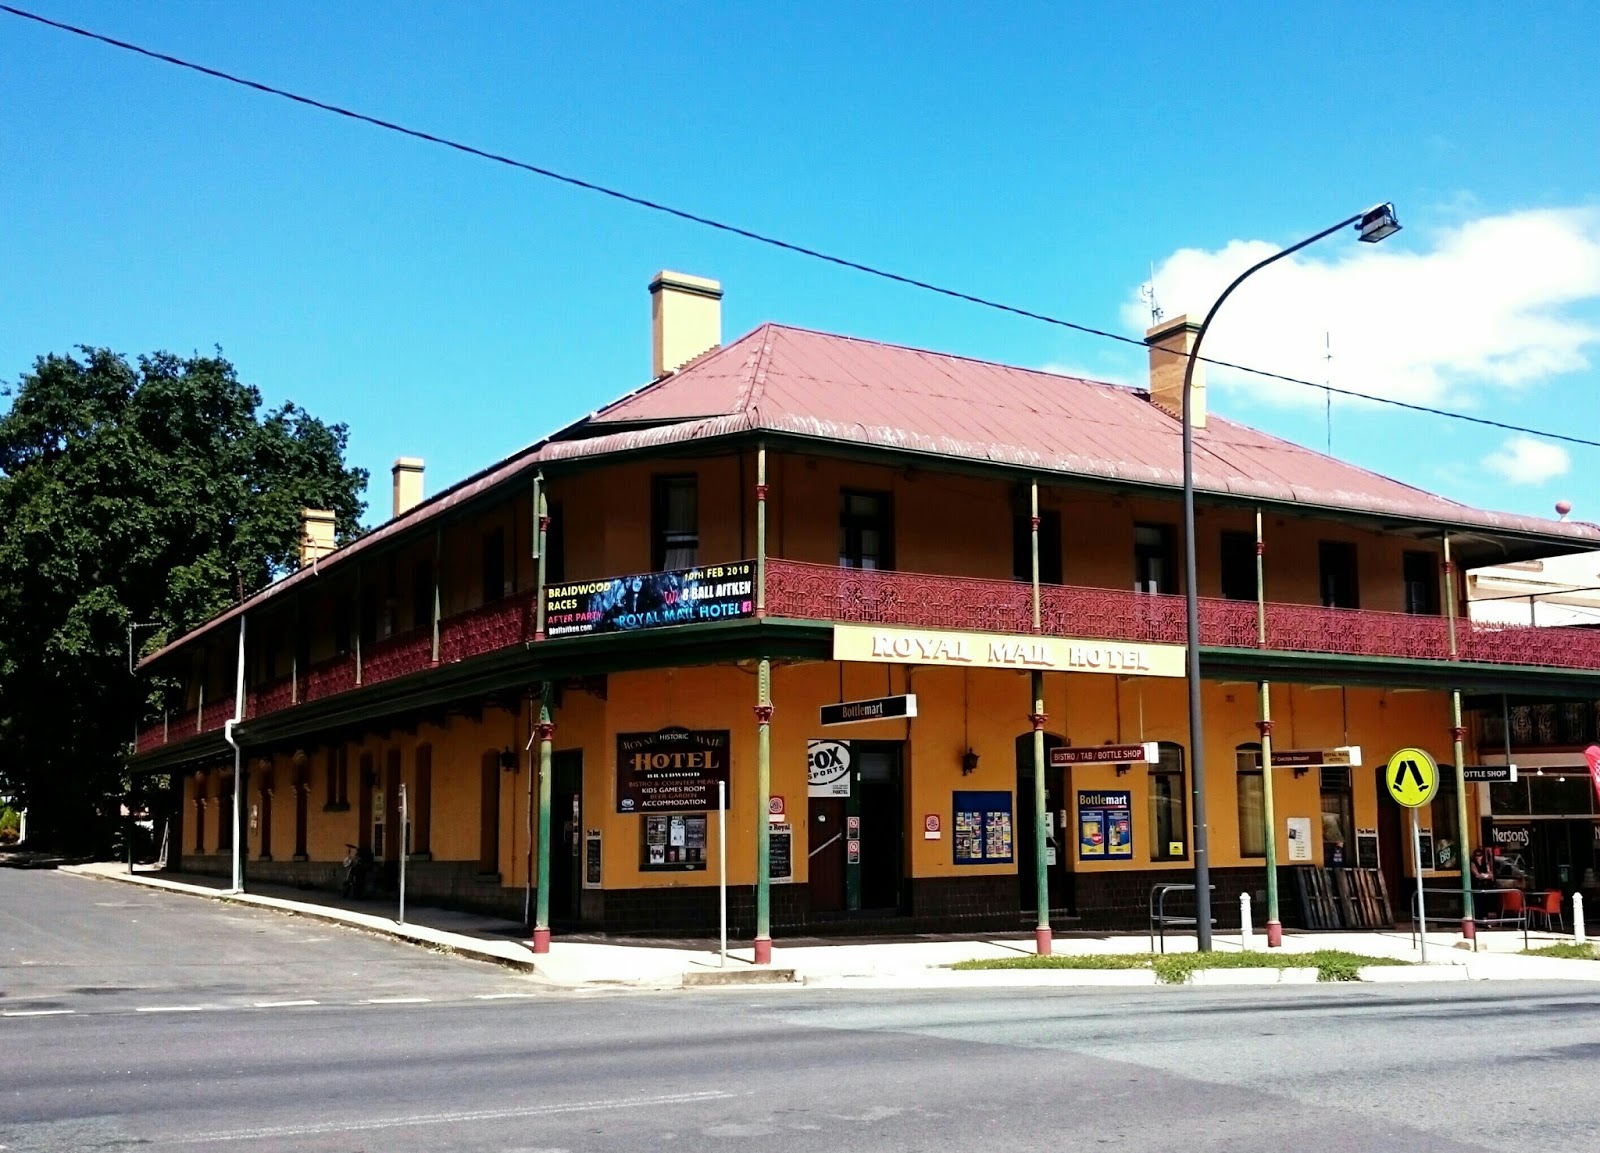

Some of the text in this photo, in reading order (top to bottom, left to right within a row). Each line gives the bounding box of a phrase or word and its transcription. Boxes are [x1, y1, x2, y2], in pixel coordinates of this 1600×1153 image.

[684, 565, 750, 581] 10TH FEB 2018
[548, 582, 611, 598] BRAIDWOOD
[682, 588, 690, 600] 8
[691, 585, 714, 600] BALL
[715, 581, 751, 597] AITKEN
[548, 599, 578, 611] RACES
[548, 611, 603, 625] AFTER PARTY
[618, 602, 740, 626] ROYAL MAIL HOTEL
[871, 635, 1150, 671] ROYAL MAIL HOTEL
[842, 702, 883, 718] Bottlemart
[623, 736, 656, 750] ROYAL
[634, 751, 719, 771] HOTEL
[808, 746, 843, 773] FOX
[1080, 752, 1092, 760] TAB
[1097, 750, 1122, 759] BOTTLE
[1123, 749, 1142, 758] SHOP
[808, 764, 845, 780] SPORTS
[642, 799, 706, 807] ACCOMMODATION
[1079, 794, 1127, 805] Bottlemart
